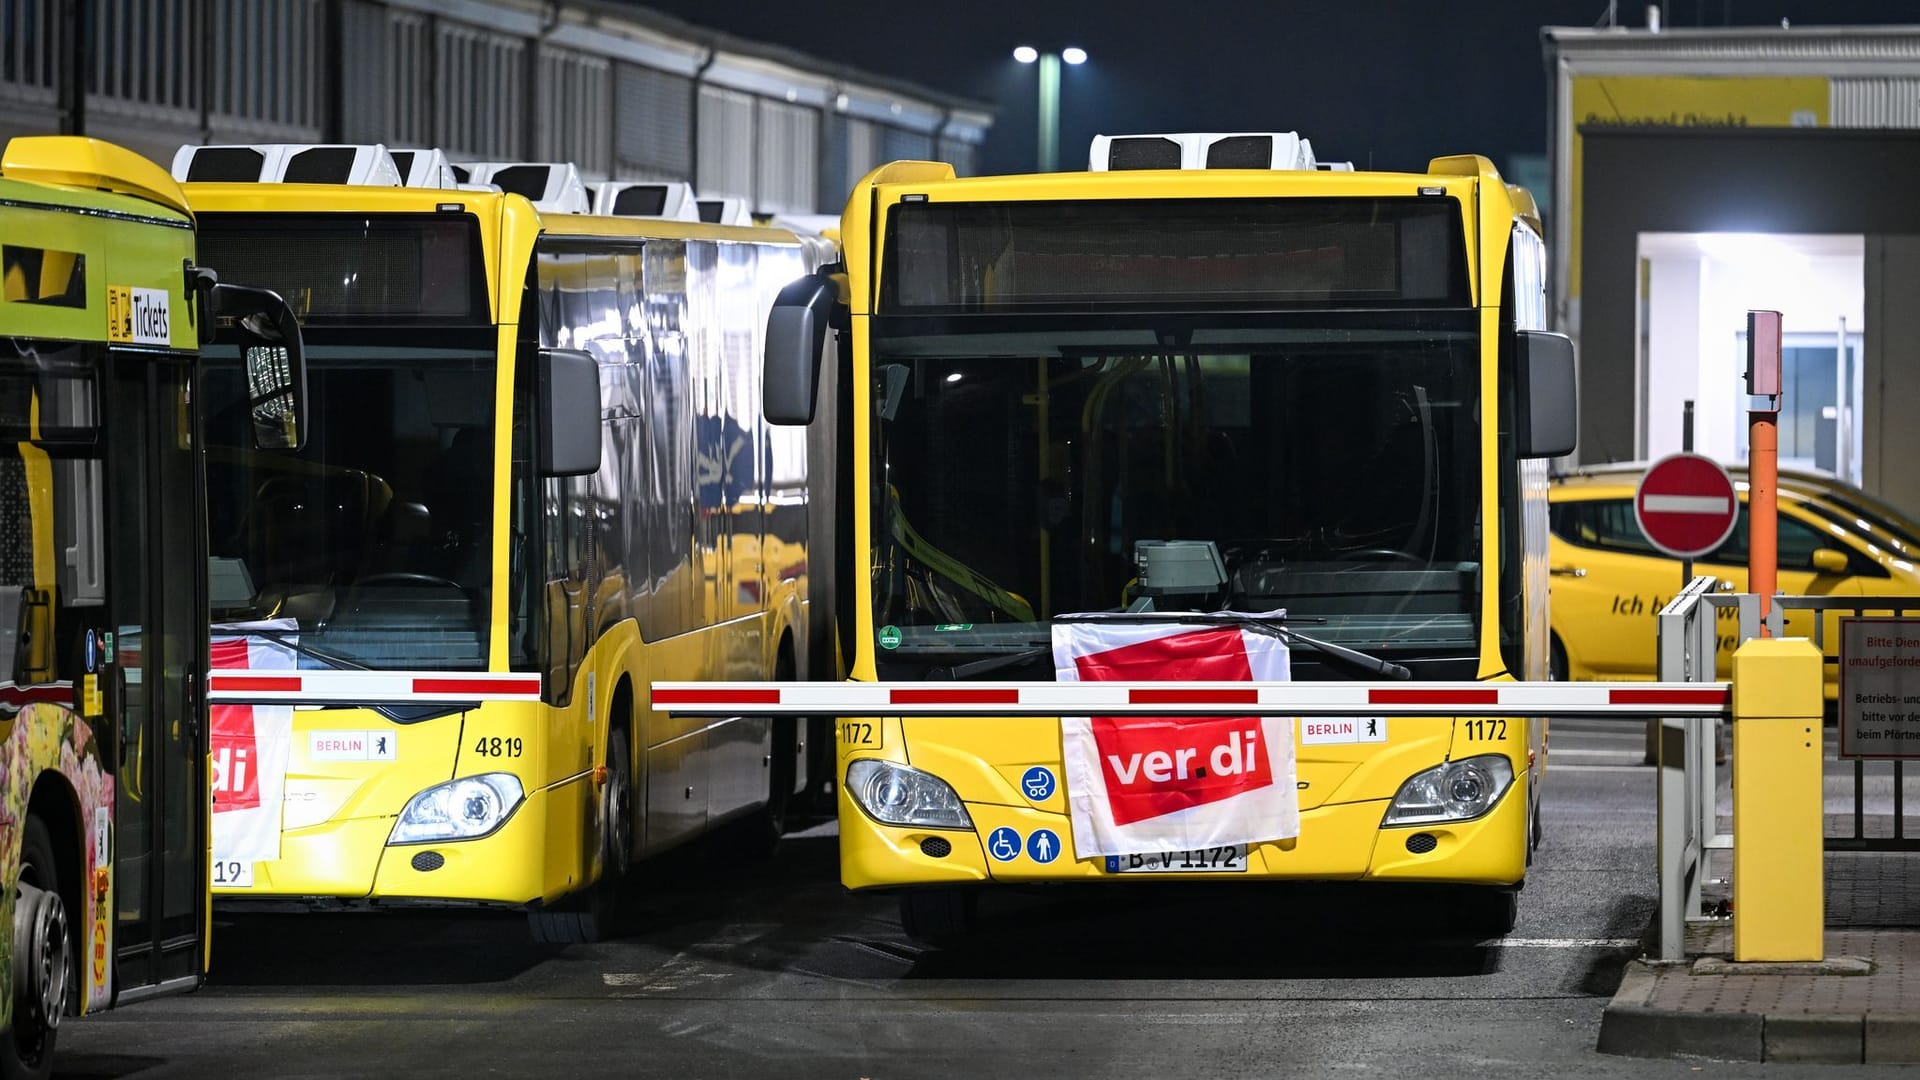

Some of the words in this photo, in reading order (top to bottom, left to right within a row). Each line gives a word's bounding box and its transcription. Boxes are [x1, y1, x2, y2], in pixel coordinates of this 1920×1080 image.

[134, 294, 168, 339] Tickets
[1612, 595, 1643, 615] Ich
[1866, 636, 1893, 648] Bitte
[1855, 693, 1900, 704] Betriebs-
[1861, 711, 1886, 722] bitte
[1889, 713, 1905, 722] vor
[841, 723, 873, 744] 1172
[1307, 723, 1353, 735] BERLIN
[1464, 719, 1508, 741] 1172
[1856, 728, 1881, 740] beim
[316, 740, 362, 751] BERLIN
[475, 736, 523, 758] 4819
[1108, 731, 1257, 785] ver.di
[1180, 845, 1238, 868] 1172
[213, 861, 242, 883] 19
